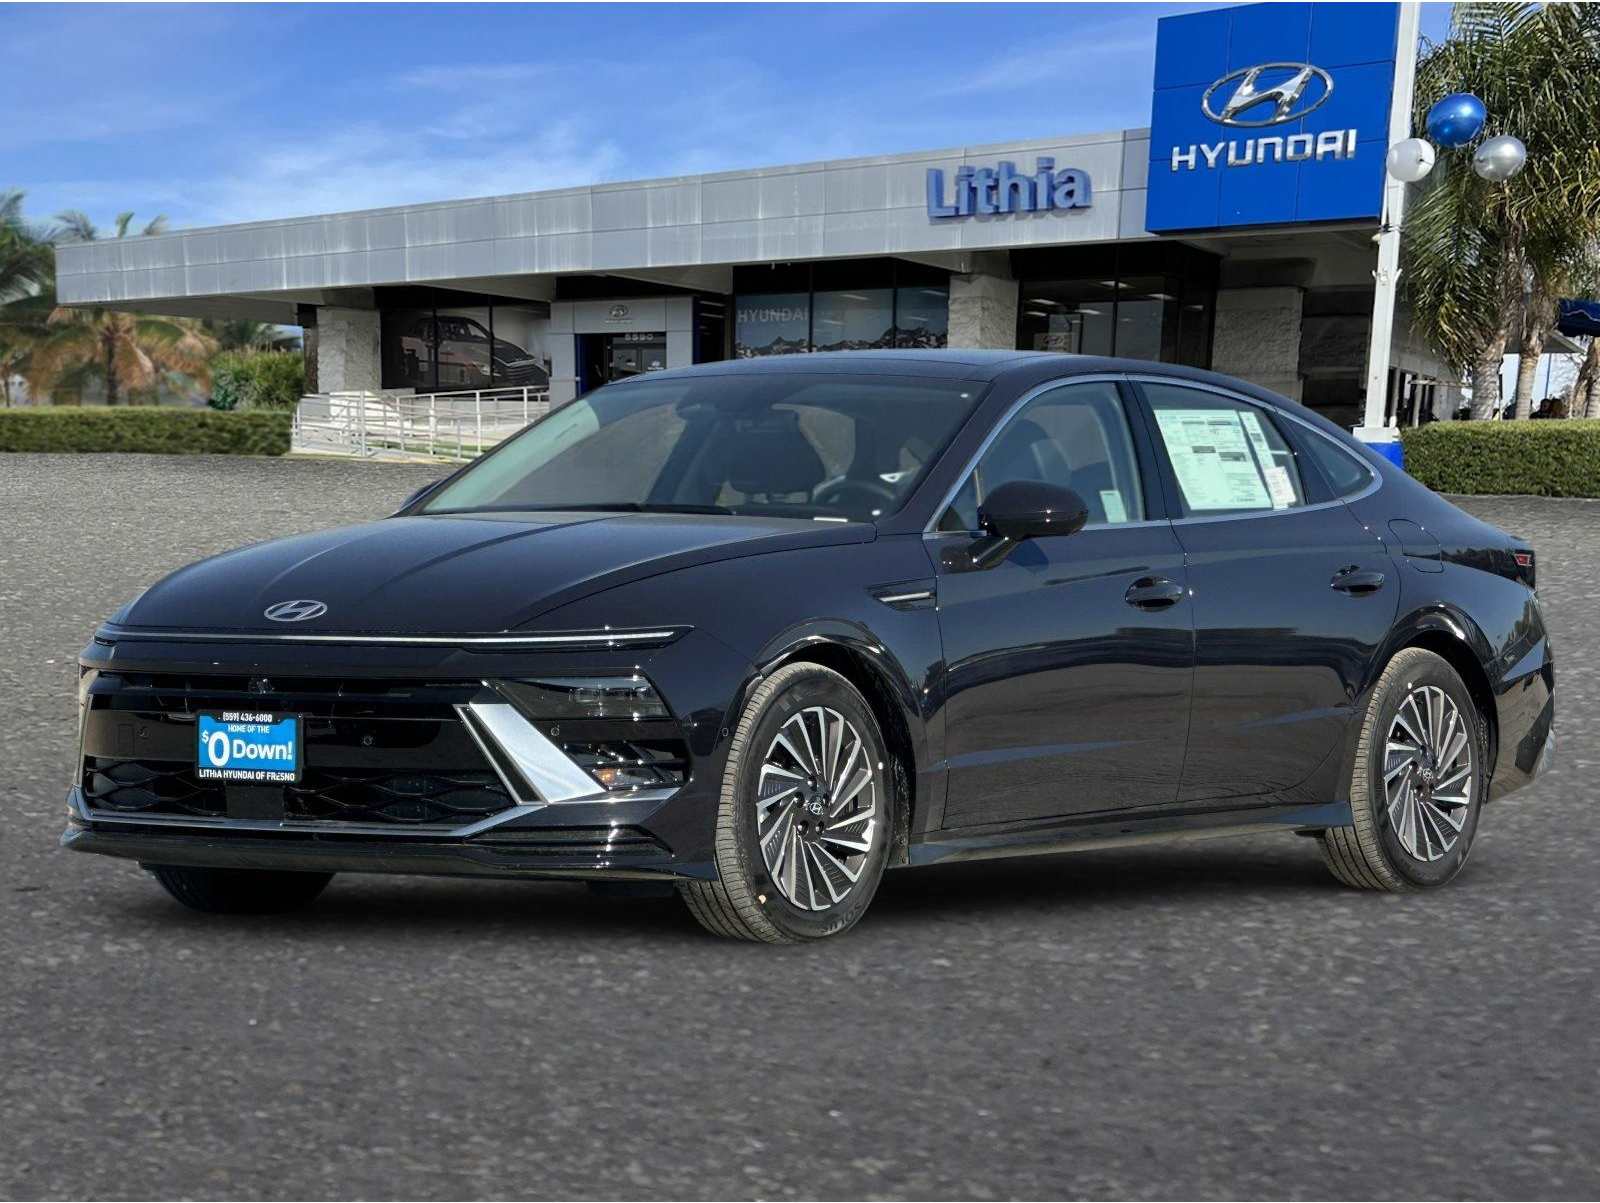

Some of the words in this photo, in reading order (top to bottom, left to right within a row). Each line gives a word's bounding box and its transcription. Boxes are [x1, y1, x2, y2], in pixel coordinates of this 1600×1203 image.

[1171, 129, 1357, 172] HYUNDAI
[926, 156, 1092, 217] Lithia
[737, 308, 809, 323] HYUNDAI
[228, 725, 244, 733] HOME
[247, 725, 256, 733] OF
[257, 725, 270, 733] THE
[232, 739, 293, 760] Down!
[223, 770, 255, 780] HYUNDAI
[255, 771, 265, 780] OF
